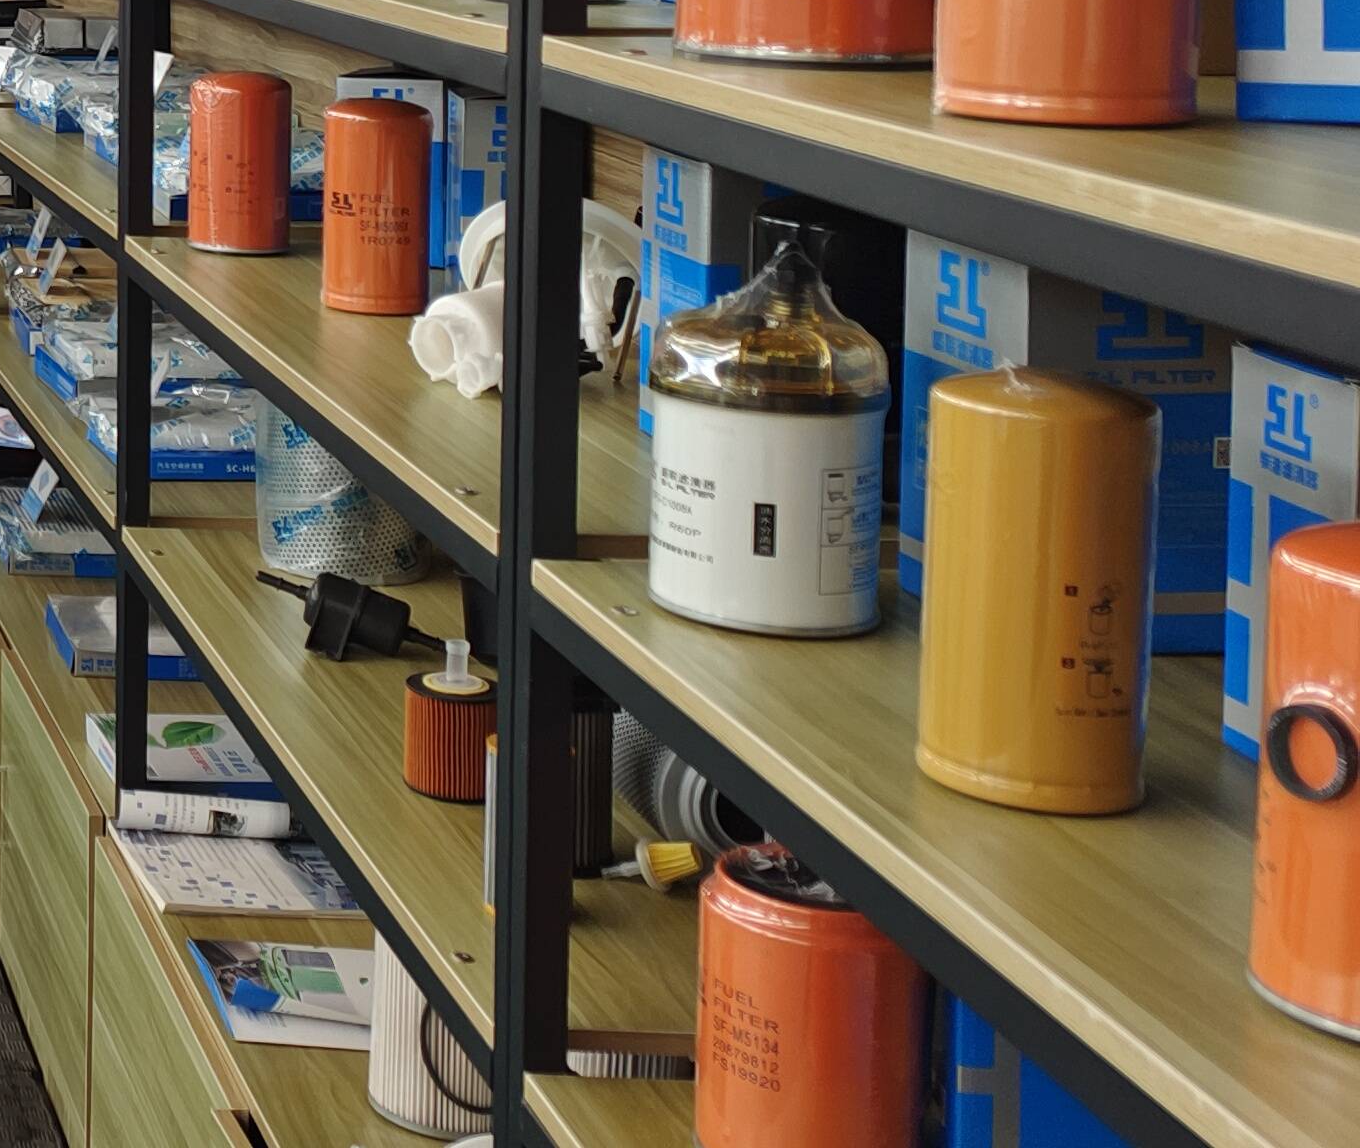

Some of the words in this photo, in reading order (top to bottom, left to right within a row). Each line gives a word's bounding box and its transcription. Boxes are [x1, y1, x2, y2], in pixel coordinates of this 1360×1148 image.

[360, 194, 393, 204] FUEL
[359, 206, 411, 218] FILTER
[1132, 369, 1217, 385] FILTER
[714, 978, 760, 1010] FUEL
[713, 997, 780, 1035] FILTER
[712, 1051, 781, 1093] FS19920
